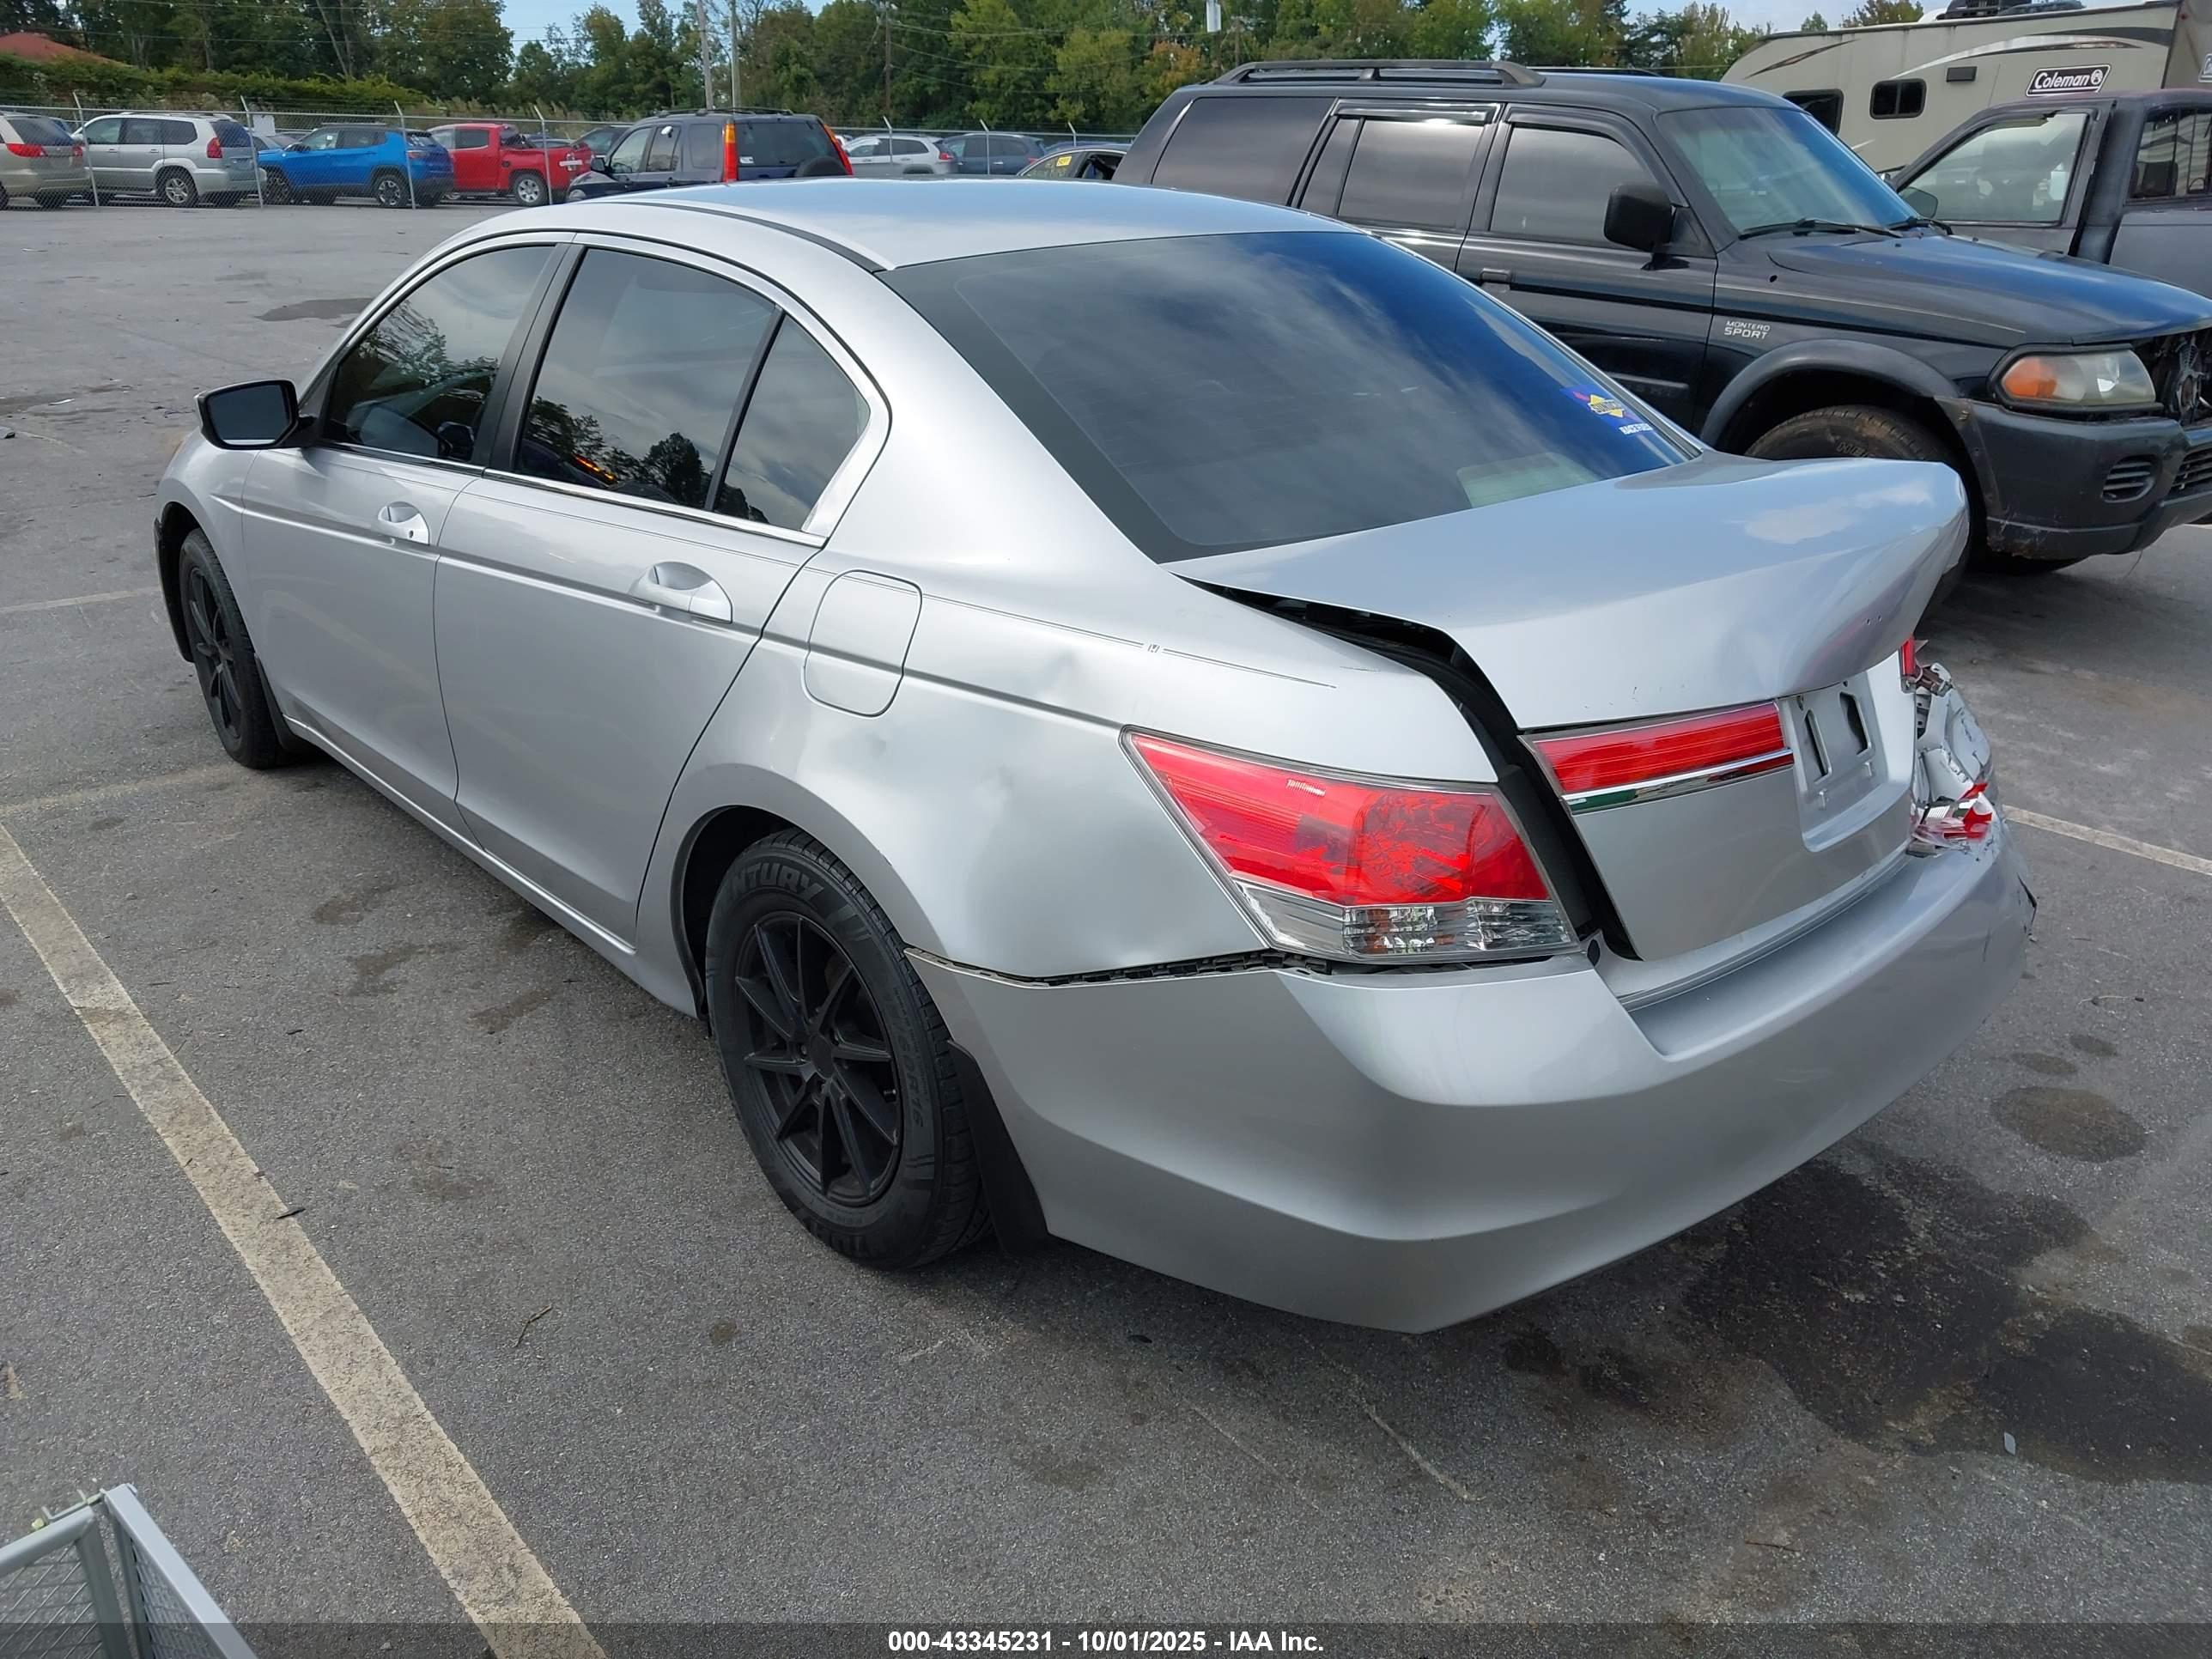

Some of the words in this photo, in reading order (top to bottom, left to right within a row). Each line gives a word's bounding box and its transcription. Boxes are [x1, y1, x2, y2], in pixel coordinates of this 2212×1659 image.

[2034, 72, 2090, 89] Coleman
[1725, 320, 1771, 331] MONTERO
[1723, 327, 1768, 340] SPORT
